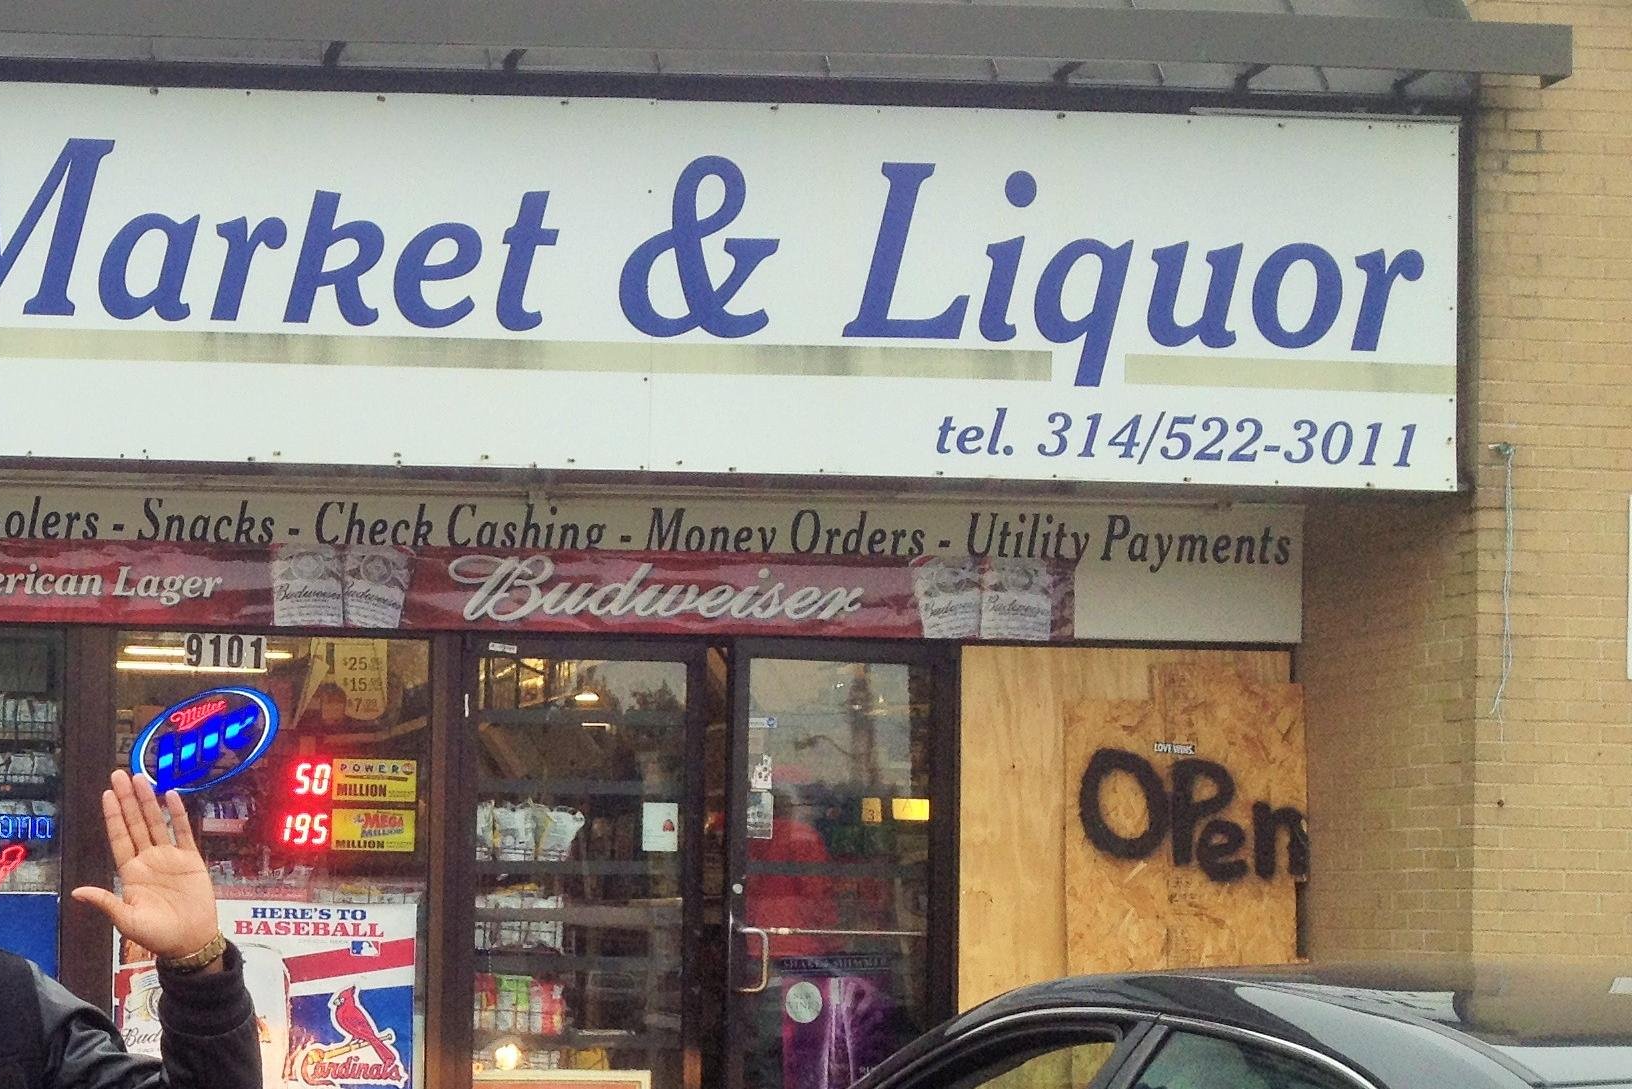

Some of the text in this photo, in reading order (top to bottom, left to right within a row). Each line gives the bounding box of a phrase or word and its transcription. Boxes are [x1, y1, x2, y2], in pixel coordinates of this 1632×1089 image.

[619, 155, 779, 338] &
[842, 160, 1424, 387] Liquor
[936, 407, 1419, 467] tel. 314/522-3011
[137, 496, 275, 544] Snacks
[315, 499, 433, 547] Check
[446, 502, 608, 550] Cashing
[646, 506, 777, 553] Money
[791, 508, 926, 556] Orders
[968, 511, 1090, 563] Utility
[1099, 513, 1291, 573] Payments
[113, 566, 224, 604] Lager
[447, 551, 862, 624] Budweiser
[186, 633, 263, 669] 9101
[294, 762, 332, 796] 50
[336, 783, 388, 798] MILLION
[282, 813, 328, 845] 195
[334, 839, 386, 850] MILLION
[234, 920, 384, 938] BASEBALL
[252, 906, 367, 921] HERE'S TO
[301, 1055, 402, 1087] Cardinals
